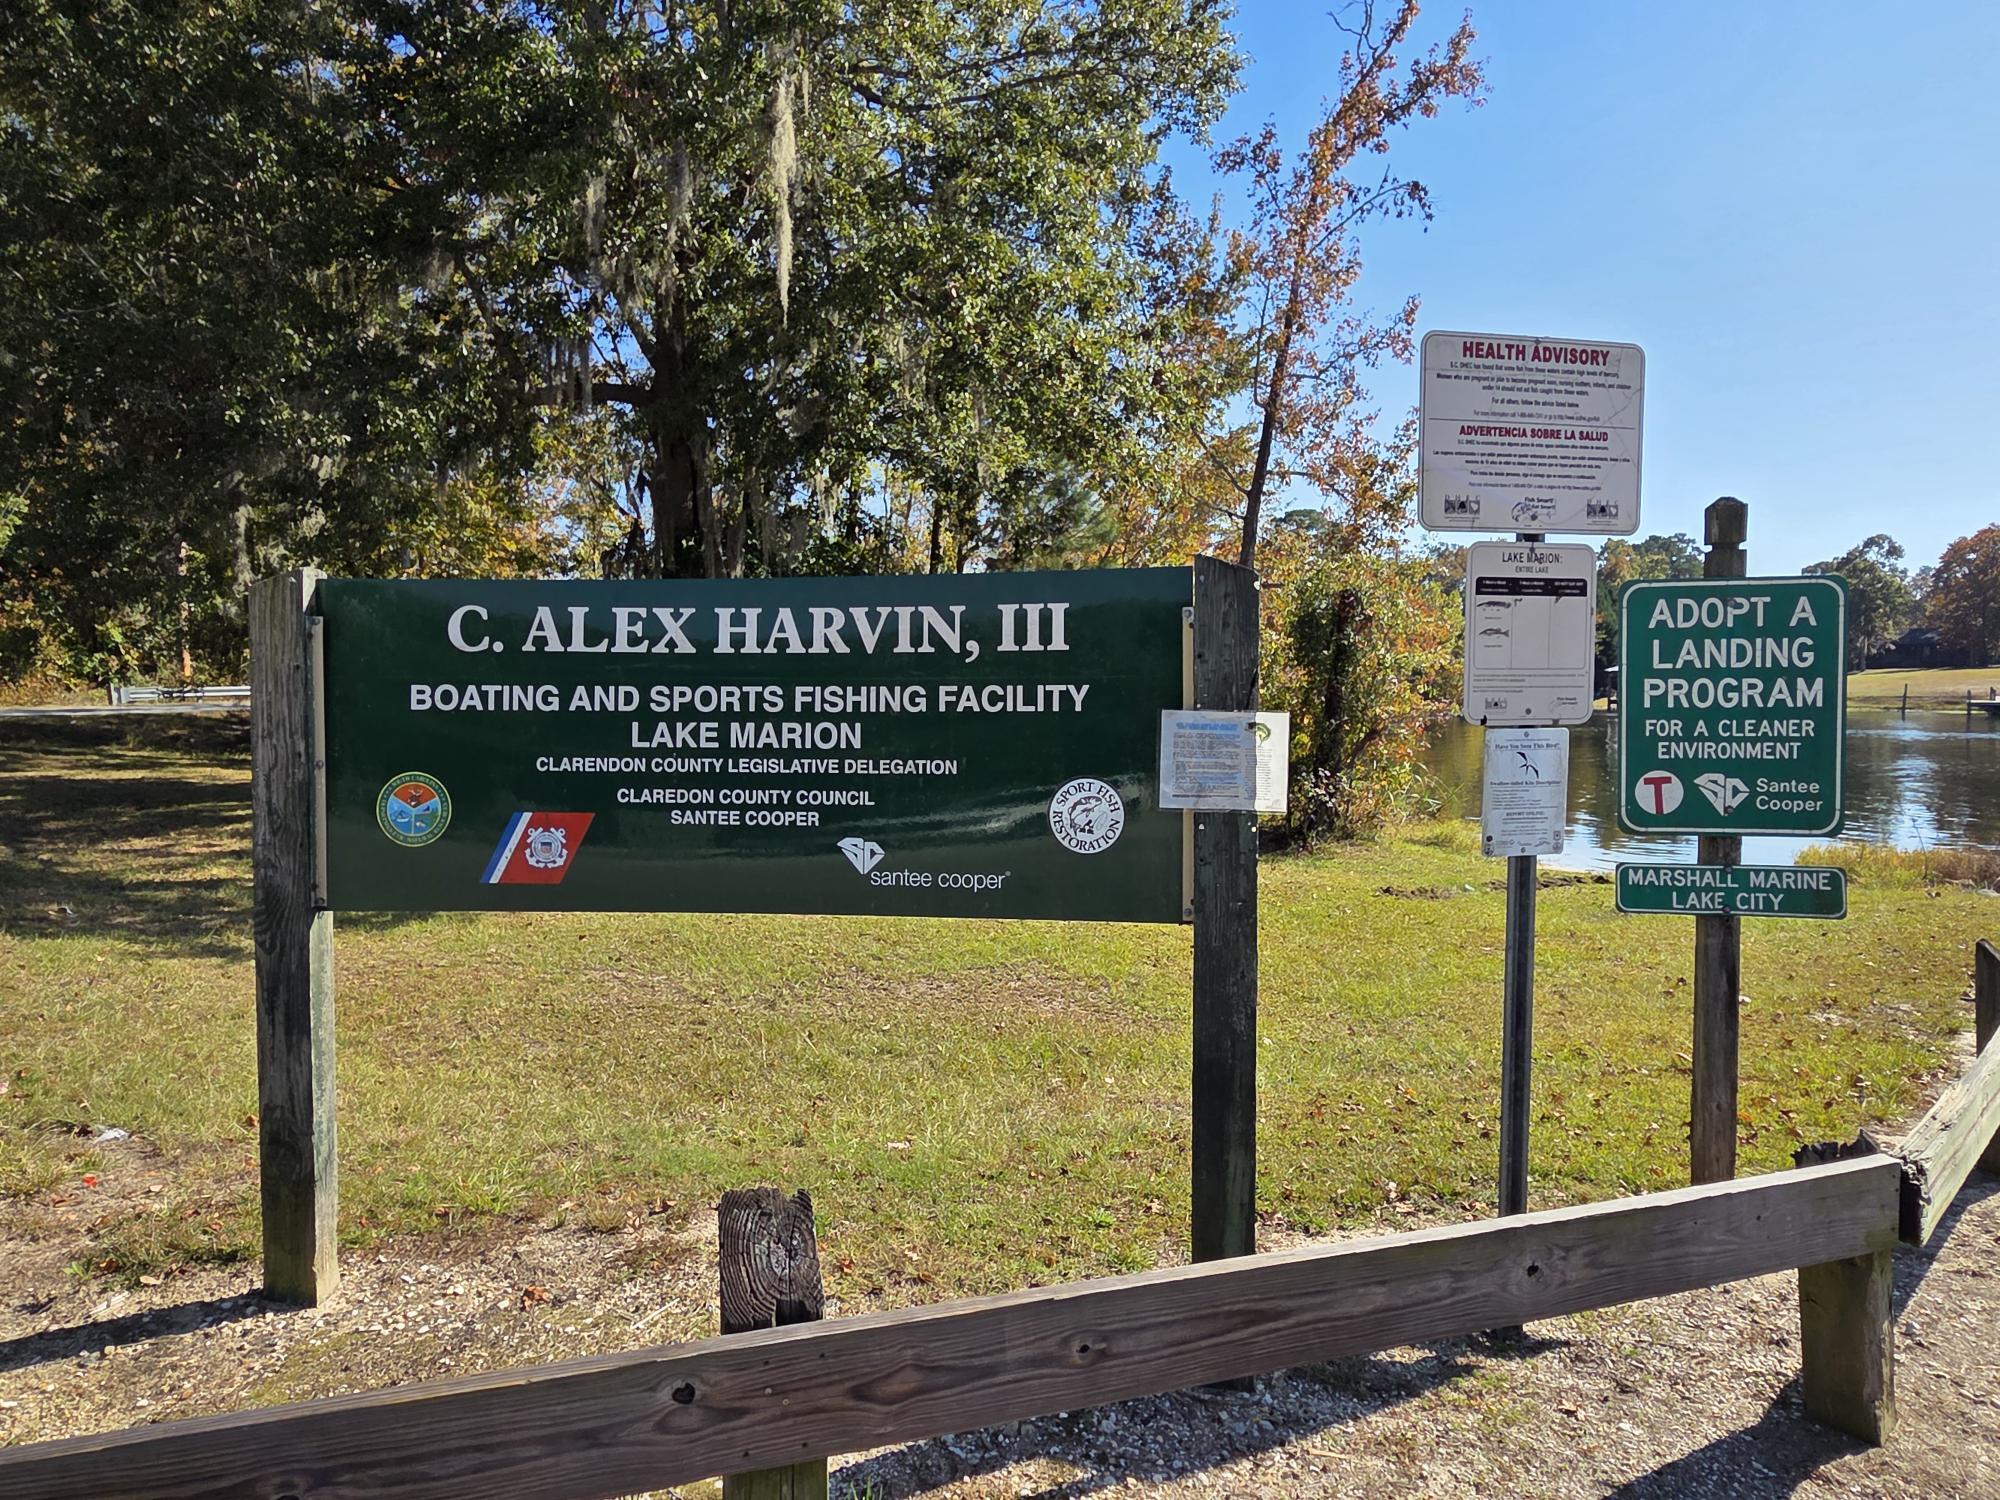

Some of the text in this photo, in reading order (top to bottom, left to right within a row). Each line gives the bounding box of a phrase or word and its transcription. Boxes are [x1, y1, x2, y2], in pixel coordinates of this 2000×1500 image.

[1463, 341, 1610, 366] HEALTH ADVISORY
[1460, 425, 1608, 442] ADVERTENCIA SOBRE LA SALUD
[1502, 552, 1523, 563] LAKE
[1515, 566, 1549, 574] ENTIRE LAKE
[1649, 596, 1817, 629] ADOPT A
[448, 603, 1070, 663] C. ALEX HARVIN, III
[1653, 637, 1814, 669] LANDING
[410, 685, 1089, 712] BOATING AND SPORTS FISHING FACILITY
[1643, 677, 1823, 709] PROGRAM
[631, 722, 861, 749] LAKE MARION
[1645, 720, 1814, 737] FOR A CLEANER
[1658, 742, 1801, 759] ENVIRONMENT
[536, 757, 957, 775] CLARENDON COUNTY LEGISLATIVE DELEGATION
[1756, 778, 1819, 794] Santee
[617, 789, 875, 806] CLAREDON COUNTY COUNCIL
[1643, 777, 1672, 815] T
[1756, 796, 1823, 813] Cooper
[671, 810, 819, 826] SANTEE COOPER
[1053, 781, 1121, 851] SPORT FISH RESTORATION
[870, 869, 932, 887] santee
[1628, 868, 1832, 891] MARSHALL MARINE
[1672, 891, 1784, 911] LAKE CITY
